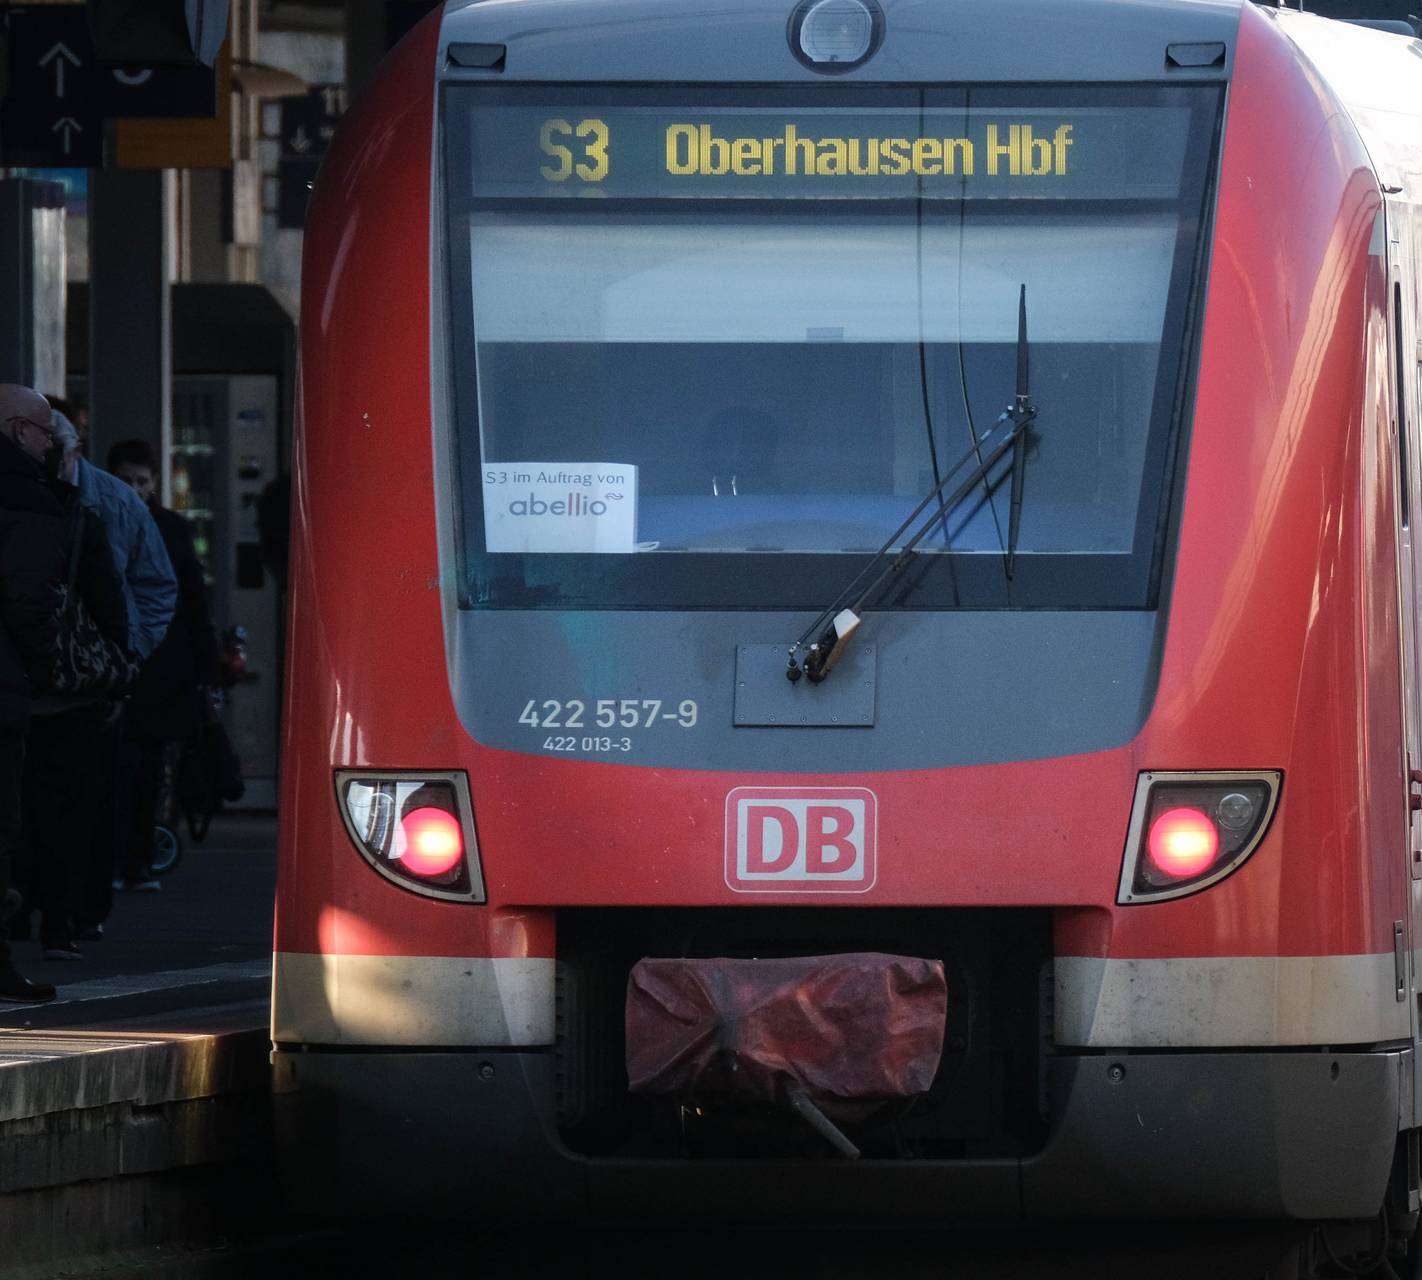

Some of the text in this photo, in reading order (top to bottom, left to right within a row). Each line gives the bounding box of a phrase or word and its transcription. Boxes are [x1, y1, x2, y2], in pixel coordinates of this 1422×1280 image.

[540, 119, 1073, 182] S3 Oberhausen Hbf
[513, 471, 531, 483] im
[536, 471, 592, 487] Auftrag
[597, 474, 625, 485] von
[509, 492, 607, 517] abellio
[518, 699, 698, 728] 422 557-9
[542, 736, 632, 752] 422 013-3
[746, 805, 857, 874] DB
